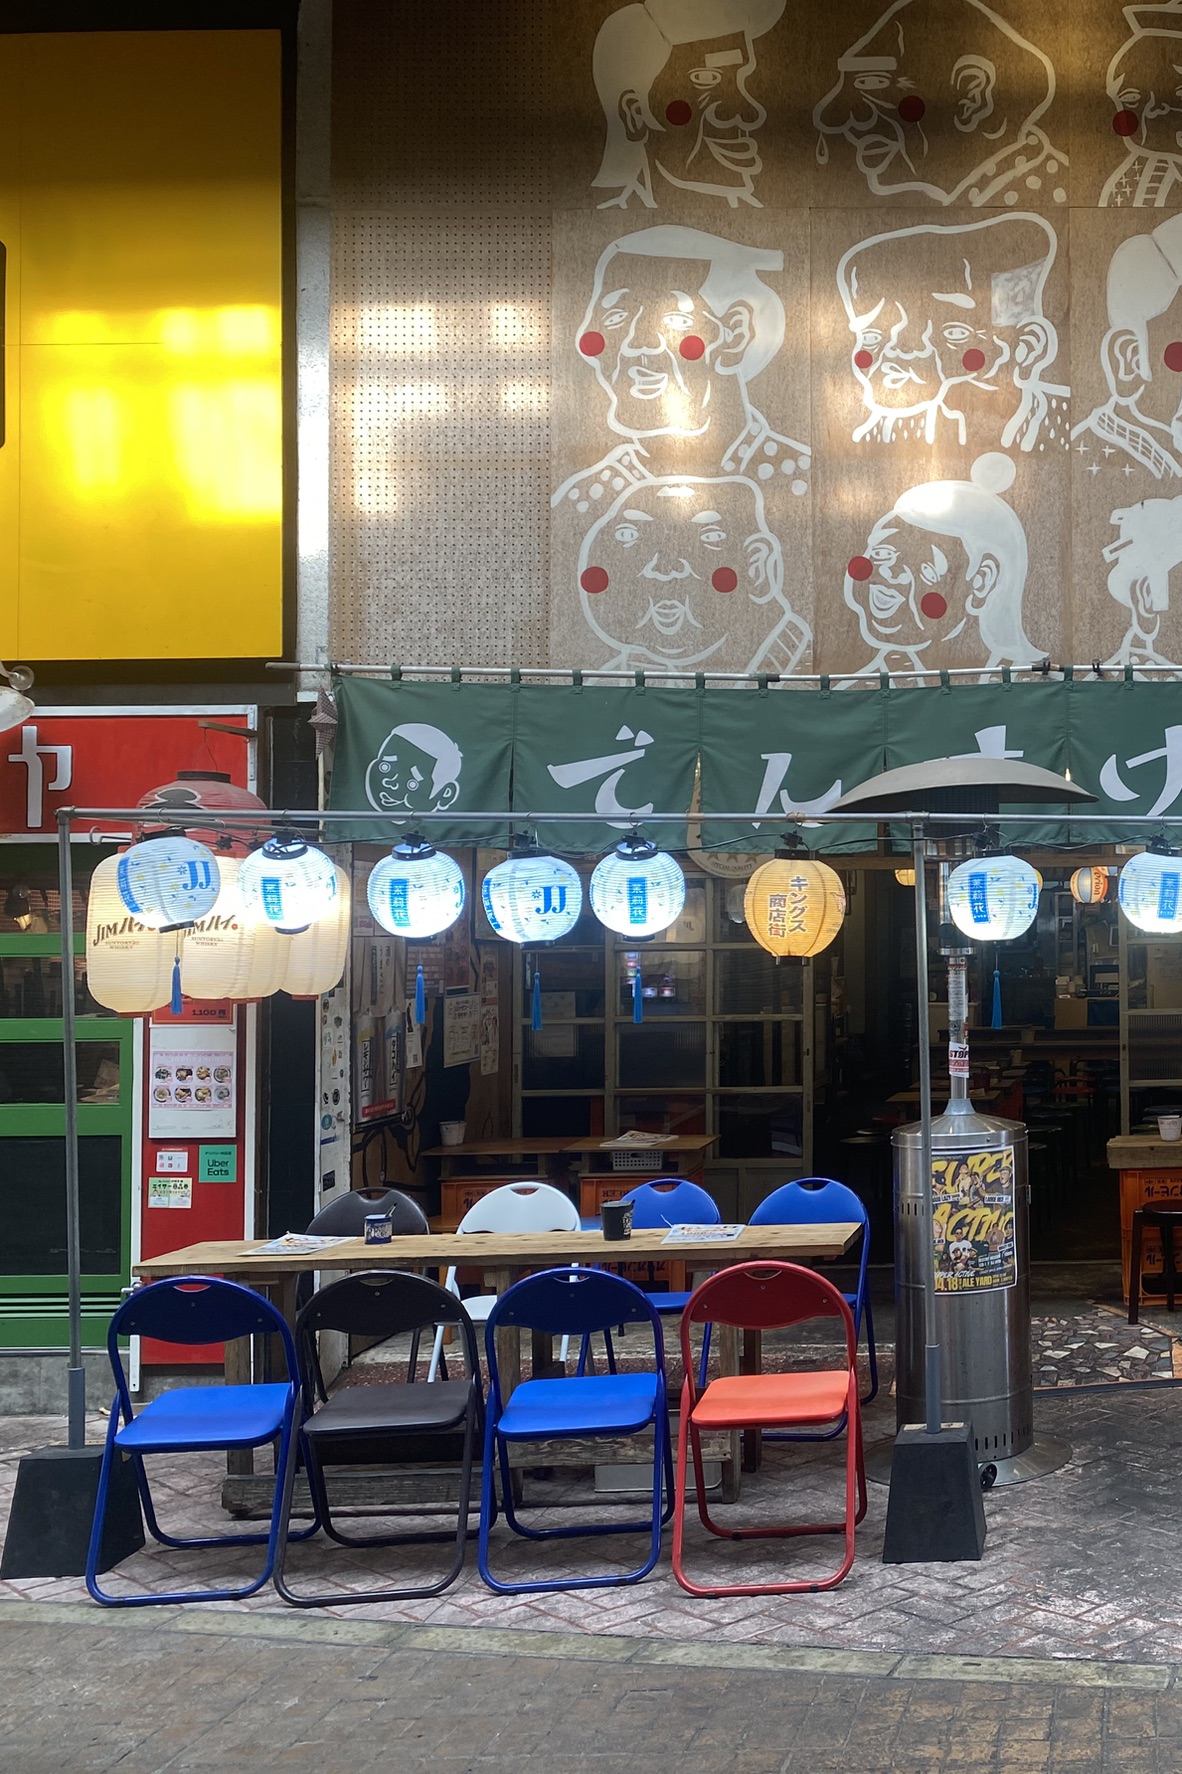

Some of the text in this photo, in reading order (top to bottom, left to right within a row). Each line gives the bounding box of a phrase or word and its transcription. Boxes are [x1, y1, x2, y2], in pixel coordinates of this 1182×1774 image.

[182, 861, 212, 891] JJ
[535, 886, 567, 914] JJ
[787, 876, 808, 934] キングス
[768, 893, 787, 938] 商店街
[207, 1168, 229, 1176] Eats
[208, 1159, 229, 1167] Uber
